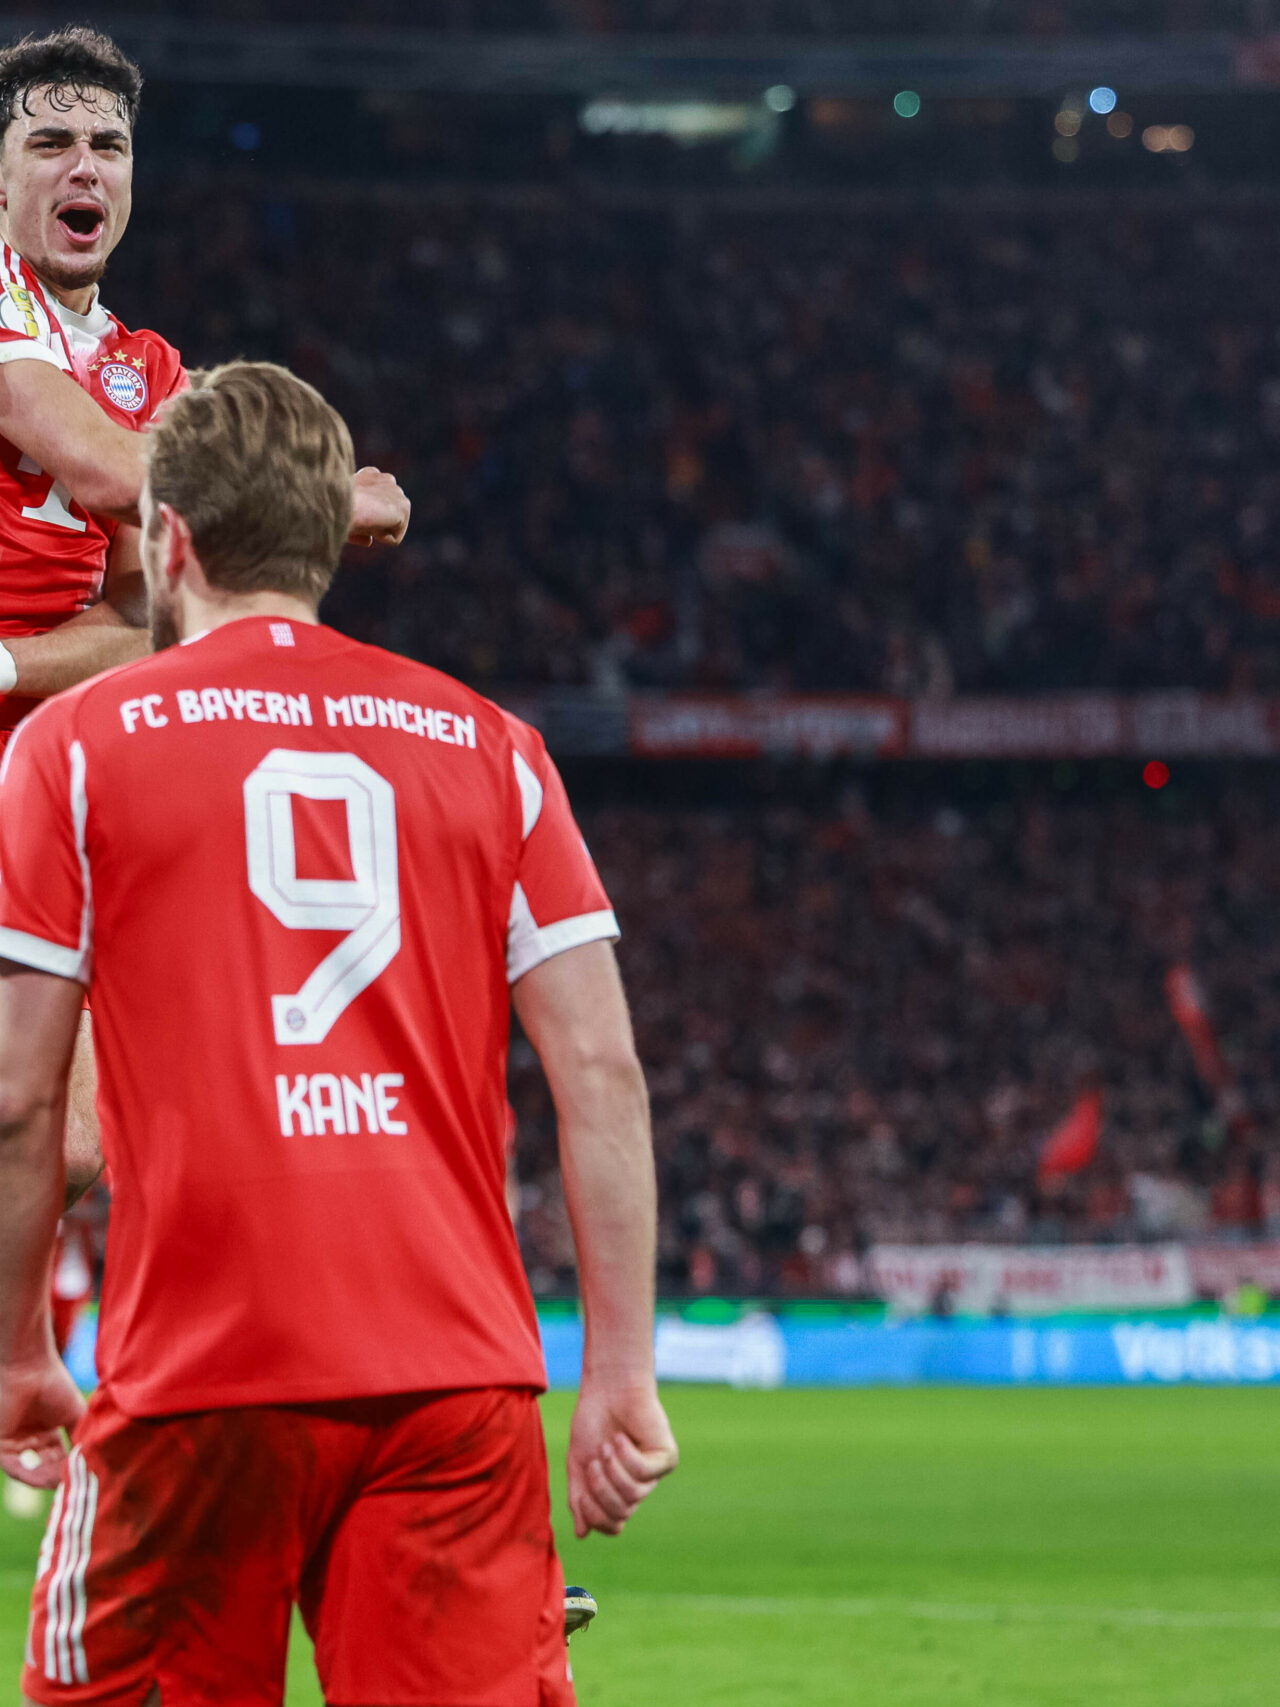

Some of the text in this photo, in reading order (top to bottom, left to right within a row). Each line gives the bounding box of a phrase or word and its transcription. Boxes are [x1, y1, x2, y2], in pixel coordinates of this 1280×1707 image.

[104, 367, 142, 389] FC BAYERN
[120, 687, 477, 749] FC BAYERN MÜNCHEN
[243, 748, 401, 1045] 9
[275, 1073, 408, 1137] KANE
